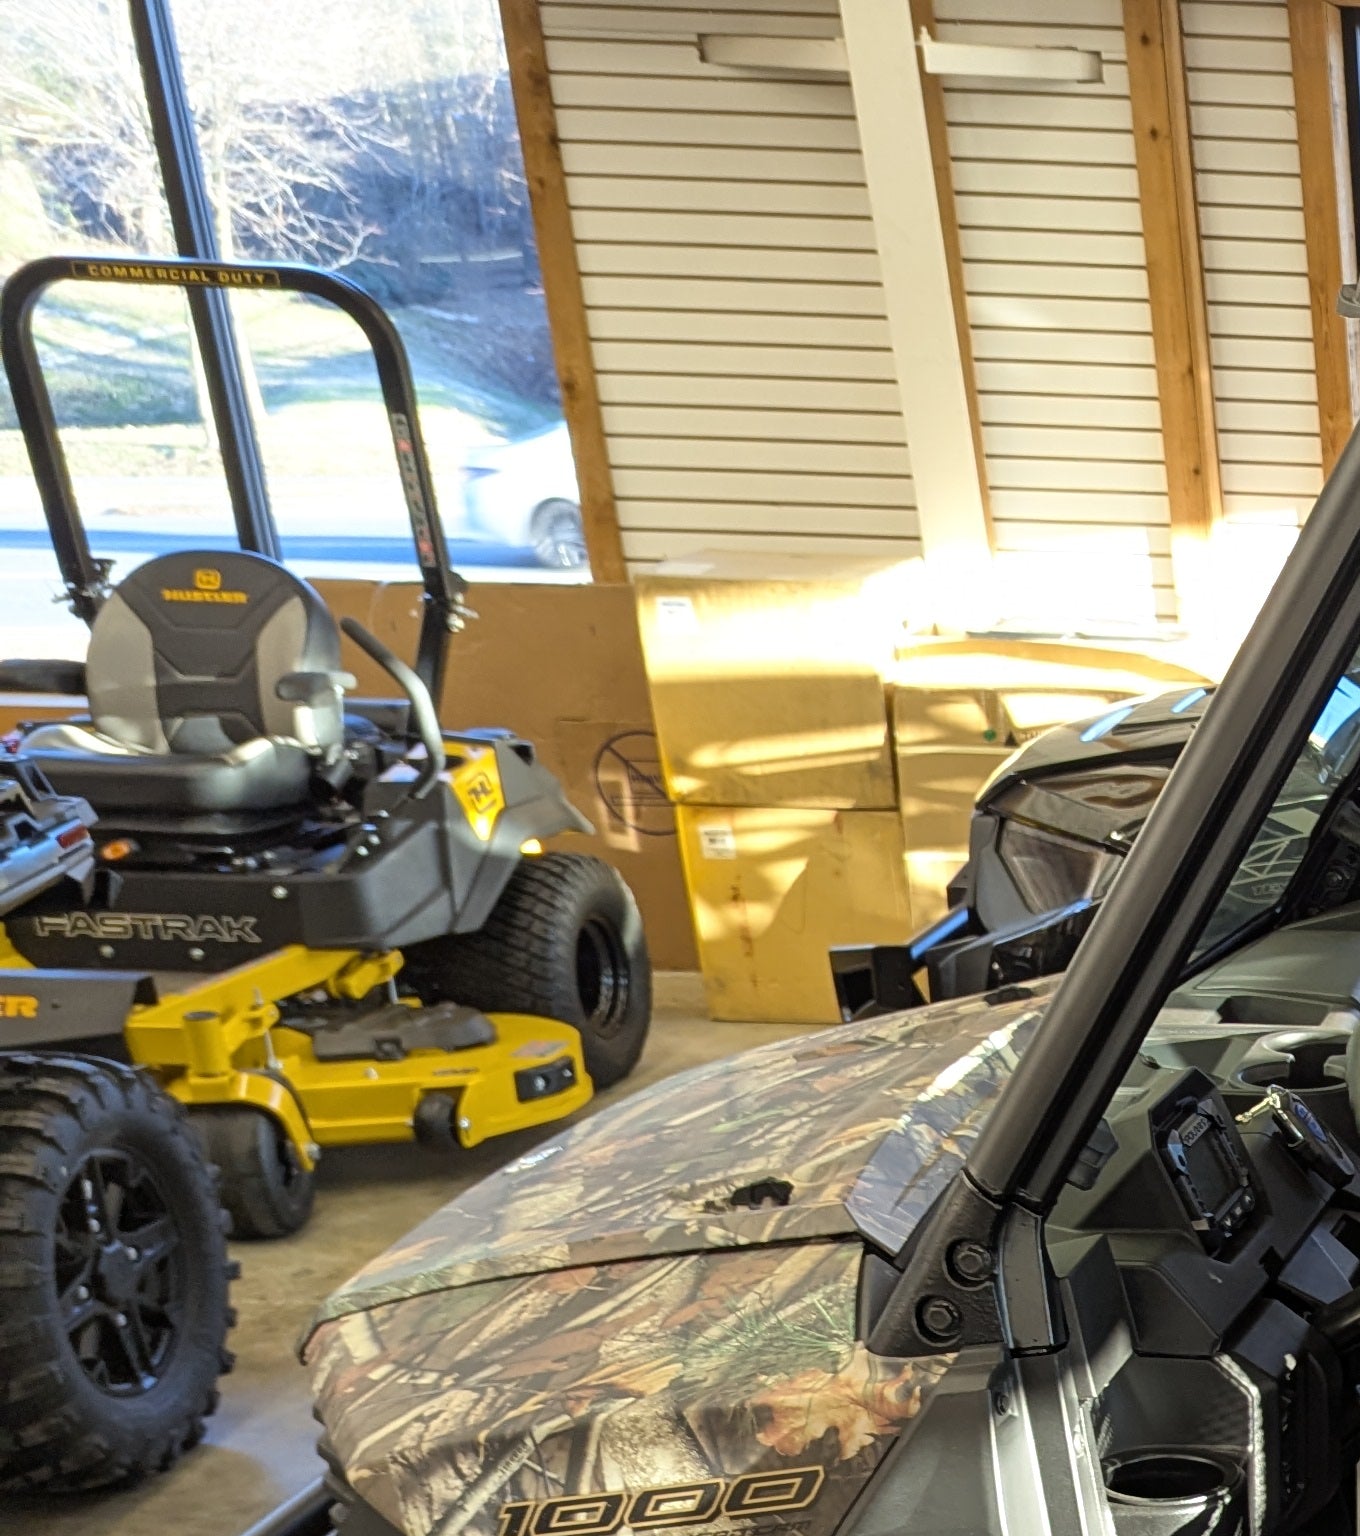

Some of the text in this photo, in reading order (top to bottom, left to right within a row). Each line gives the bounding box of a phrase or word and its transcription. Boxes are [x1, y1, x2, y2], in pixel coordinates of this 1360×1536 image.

[87, 264, 266, 285] COMMERCIAL DUTY
[160, 588, 249, 606] HUSTLER
[34, 911, 262, 943] FASTRAK
